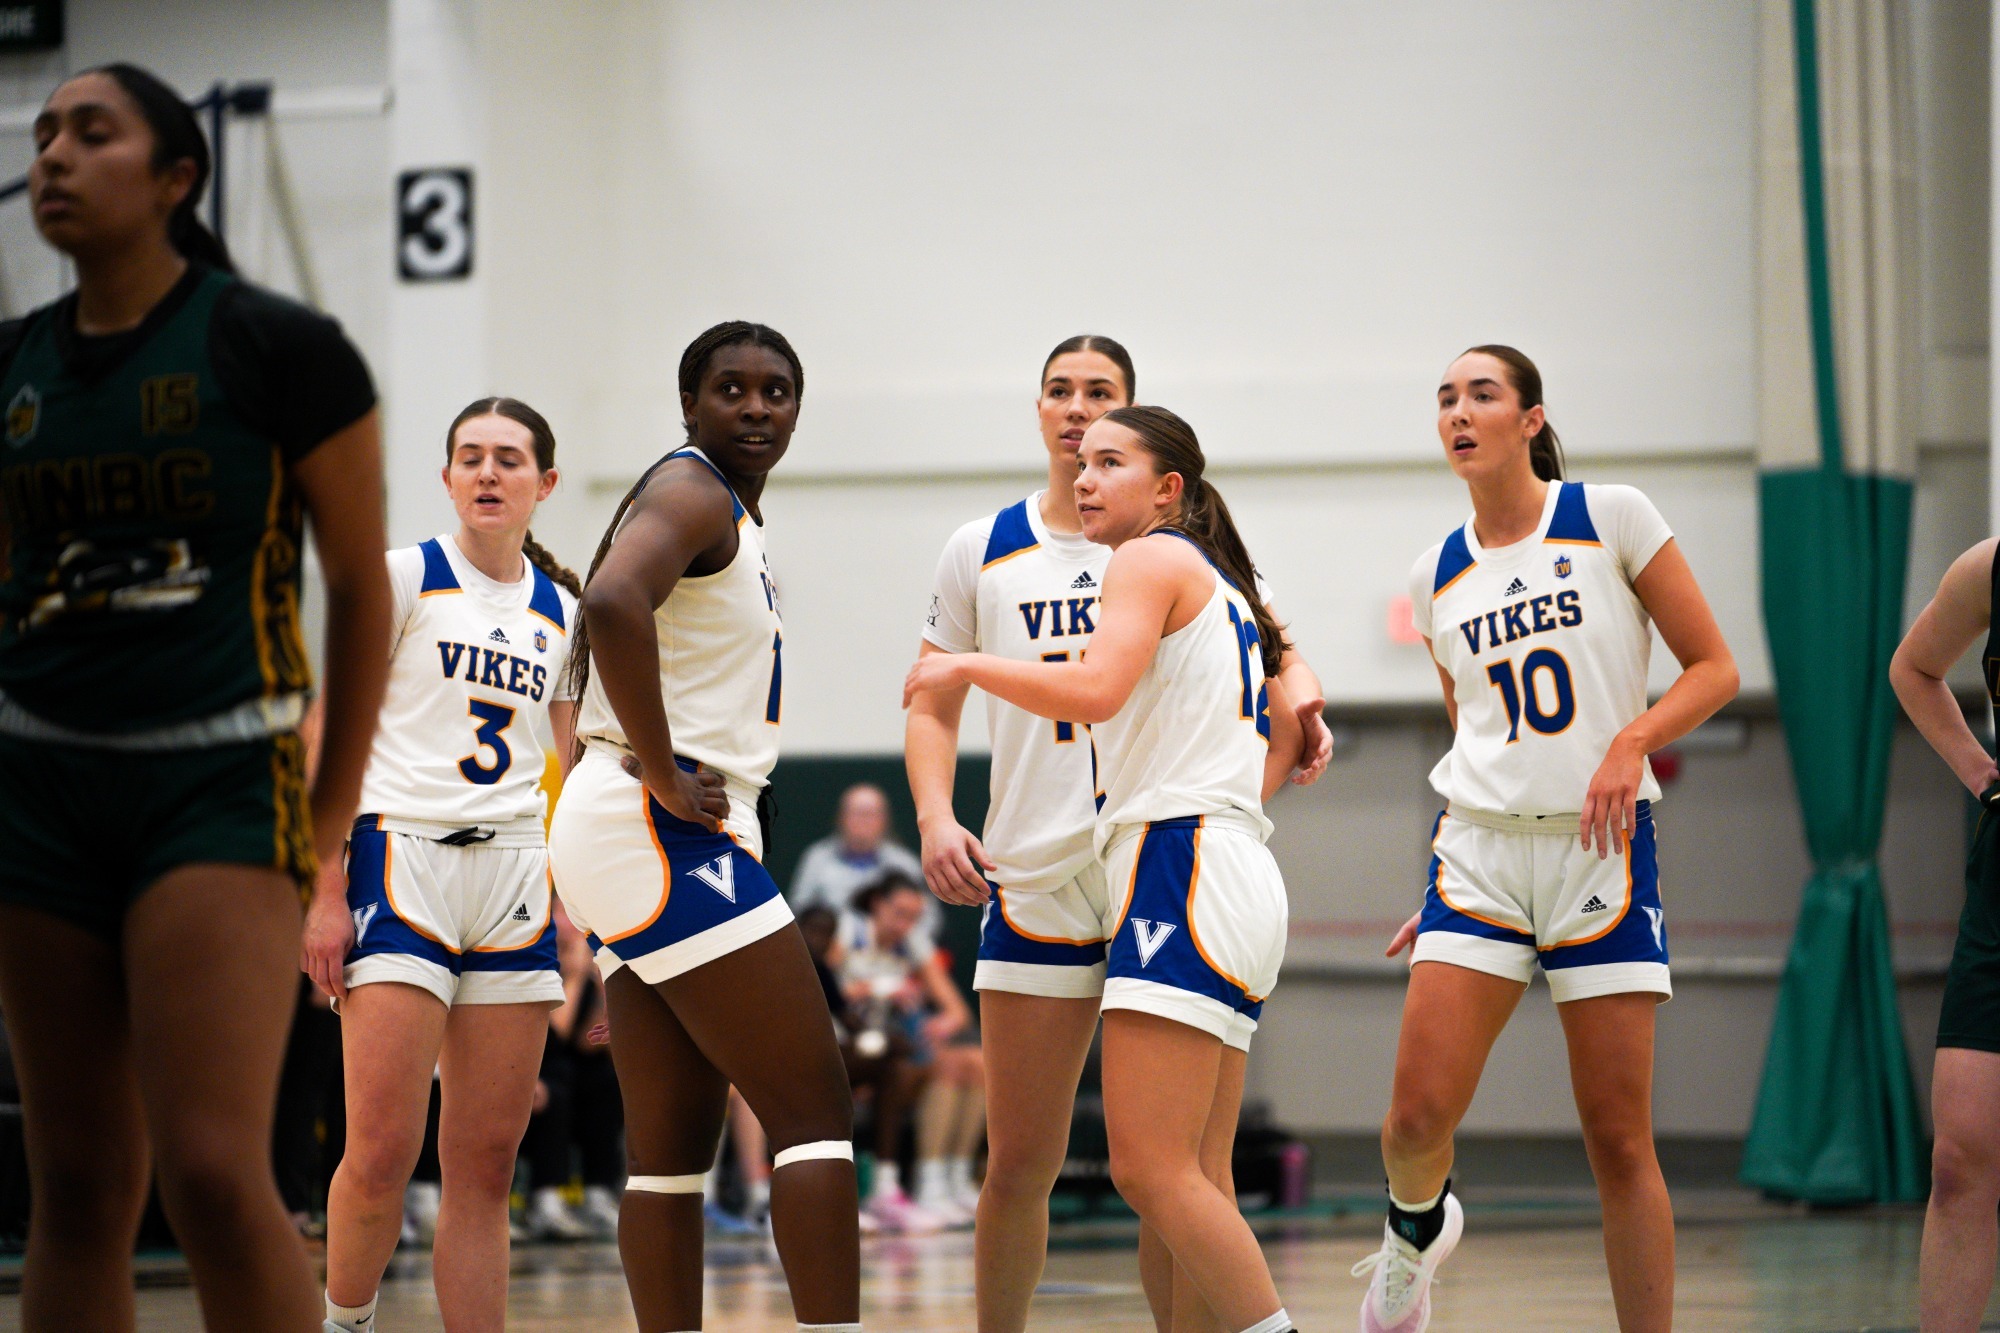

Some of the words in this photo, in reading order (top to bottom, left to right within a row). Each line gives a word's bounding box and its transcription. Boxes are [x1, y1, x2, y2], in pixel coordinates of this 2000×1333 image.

[406, 176, 466, 274] 3
[140, 373, 200, 437] 15
[1071, 581, 1097, 589] adidas
[1018, 596, 1102, 640] VIK
[1459, 589, 1584, 656] VIKES
[436, 639, 548, 703] VIKES
[1224, 594, 1271, 747] 12
[1484, 645, 1578, 746] 10
[456, 696, 518, 785] 3
[685, 851, 737, 904] V
[350, 901, 379, 949] V
[512, 914, 531, 922] adidas
[1581, 903, 1607, 914] adidas
[1641, 905, 1664, 952] V
[1130, 917, 1178, 968] V
